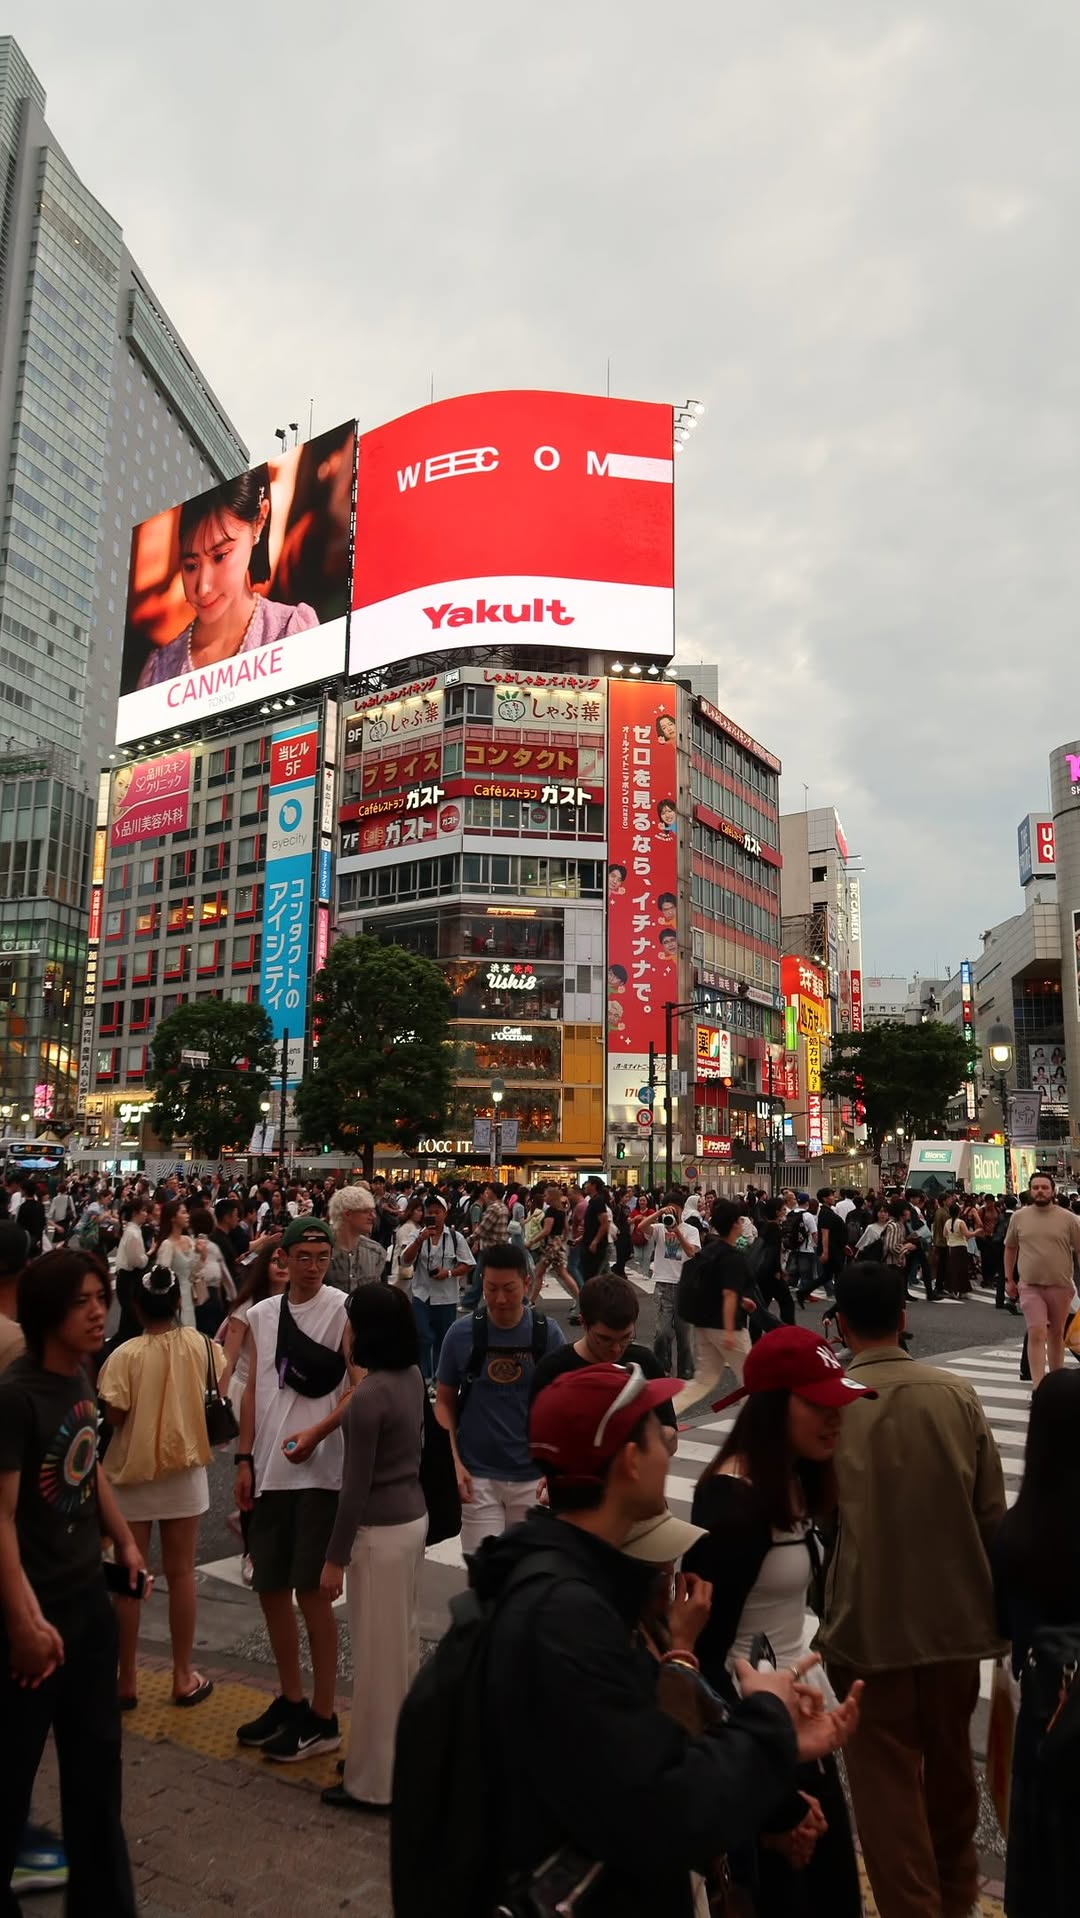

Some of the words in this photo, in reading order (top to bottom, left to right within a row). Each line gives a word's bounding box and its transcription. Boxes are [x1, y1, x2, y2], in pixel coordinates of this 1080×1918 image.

[422, 598, 575, 630] Yakult
[167, 646, 284, 708] CANMAKE
[483, 669, 600, 690] しゃぶしゃぶバイキング
[391, 702, 439, 732] しゃぶ葉
[532, 698, 600, 722] しゃぶ葉
[347, 728, 362, 743] 9F
[279, 741, 310, 762] 当ビル
[465, 745, 574, 771] コンタクト
[146, 759, 187, 781] 品川スキン
[285, 759, 302, 777] 5F
[363, 751, 440, 788] プライス
[145, 775, 182, 795] クリニック
[541, 785, 592, 806] ガスト
[406, 785, 445, 810] ガスト
[121, 807, 184, 837] 品川美容外科
[384, 816, 433, 847] ガスト
[271, 833, 307, 852] eyecity
[342, 832, 360, 849] 7F
[632, 725, 653, 1014] ゼロを見るなら、イチナナで。
[265, 881, 288, 1010] アイシティ
[285, 879, 304, 1009] コンタクトの
[924, 1151, 947, 1159] Blanc
[973, 1155, 1000, 1179] Blanc
